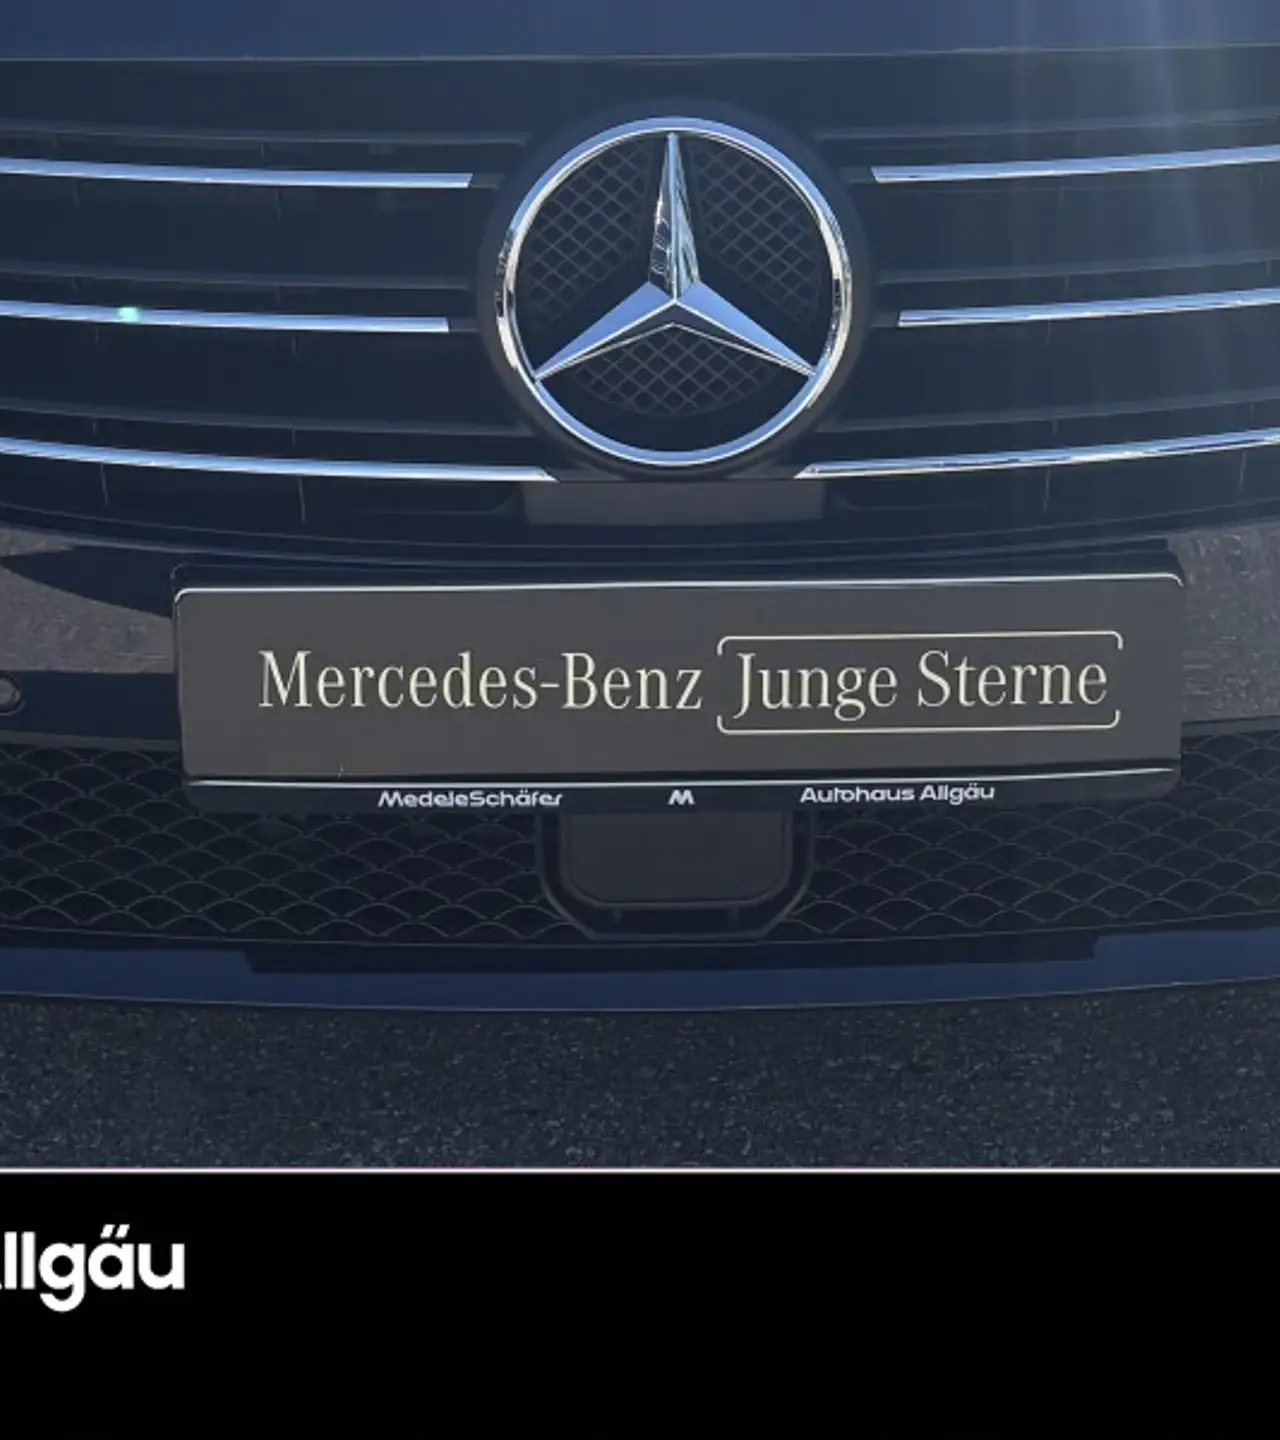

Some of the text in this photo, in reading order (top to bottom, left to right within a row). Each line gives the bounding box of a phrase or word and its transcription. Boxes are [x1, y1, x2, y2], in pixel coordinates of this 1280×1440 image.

[259, 650, 1108, 721] Mercedes-Benz Junge Sterne
[377, 789, 564, 808] MedeleSchäfer
[800, 786, 915, 803] Autohaus
[919, 782, 996, 806] Allgäu
